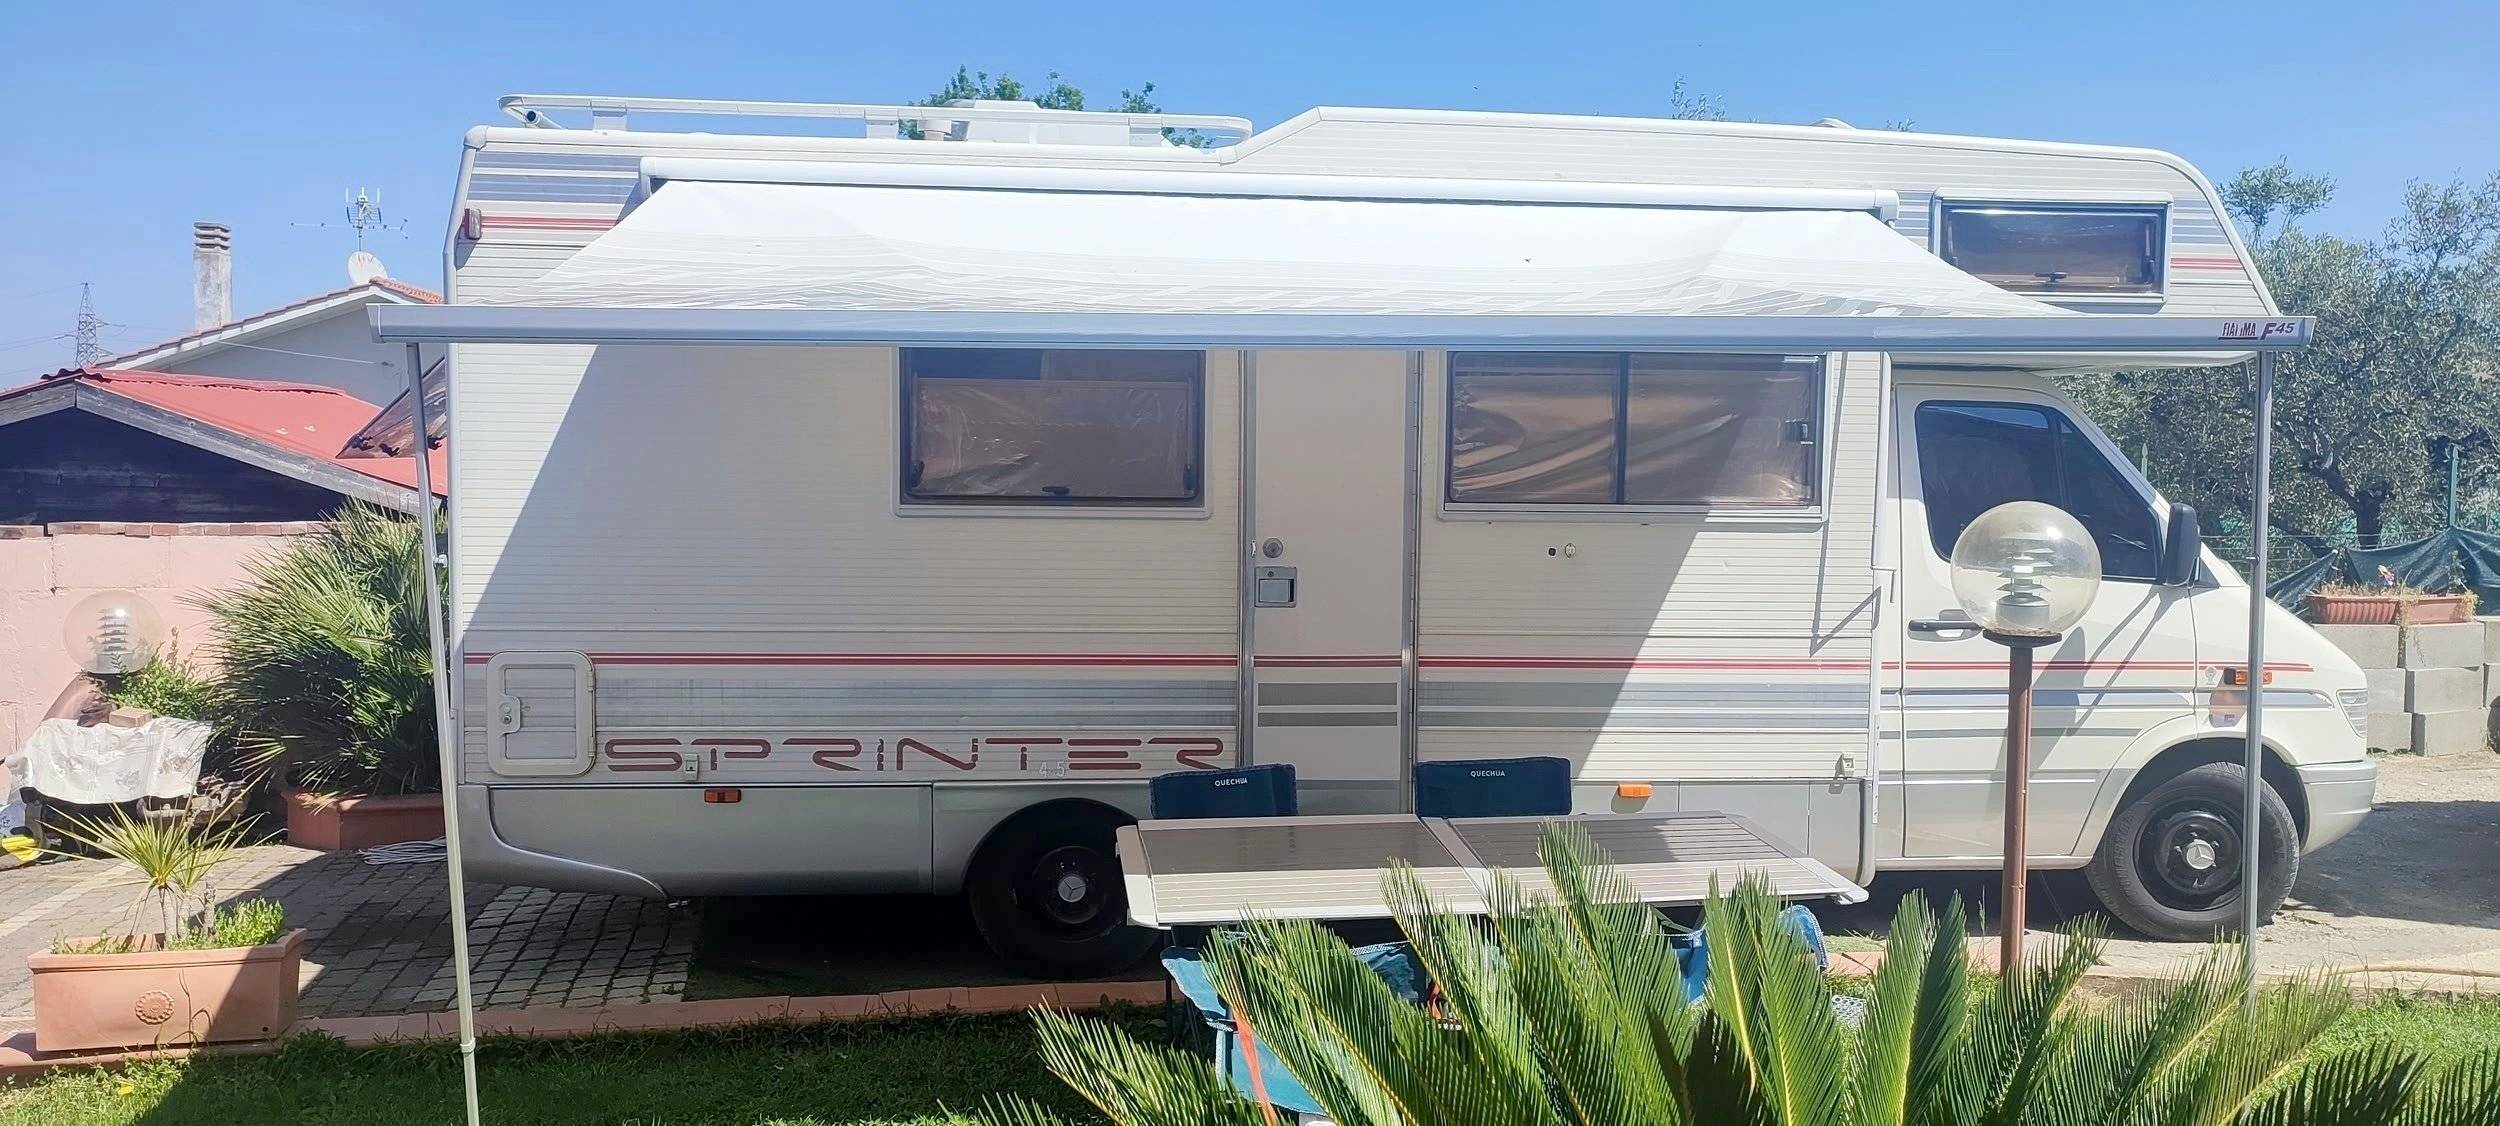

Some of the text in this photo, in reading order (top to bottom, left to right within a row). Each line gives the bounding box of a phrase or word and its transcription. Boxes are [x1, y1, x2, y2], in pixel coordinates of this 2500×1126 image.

[604, 737, 1224, 771] SPRINTER
[1470, 770, 1506, 778] QUECHUA
[1214, 777, 1248, 787] QUECHUA
